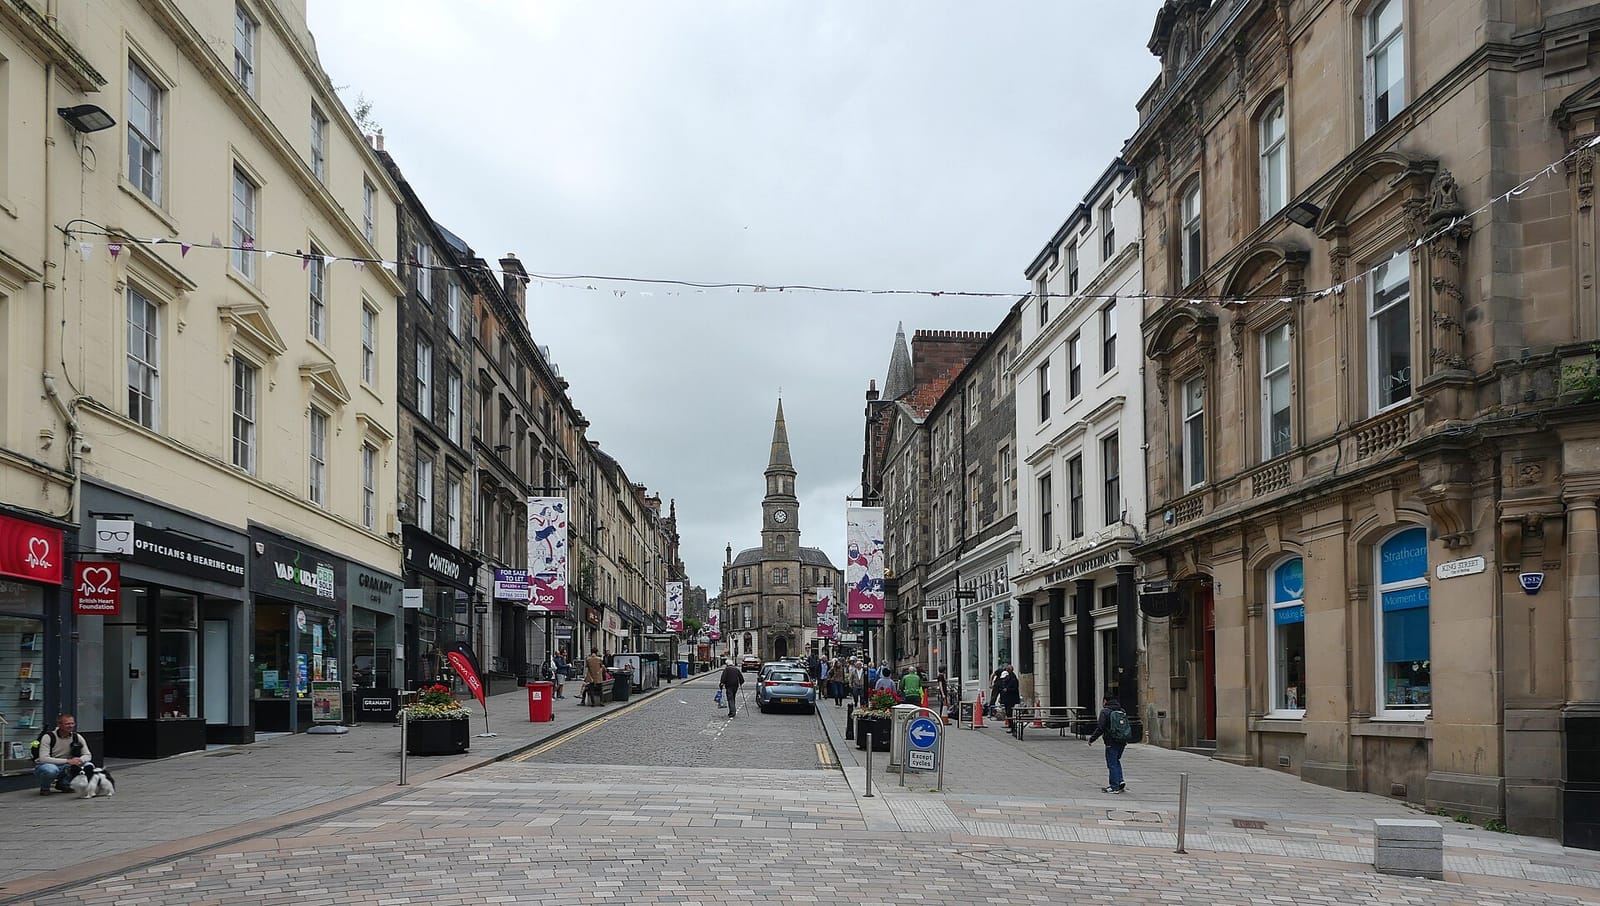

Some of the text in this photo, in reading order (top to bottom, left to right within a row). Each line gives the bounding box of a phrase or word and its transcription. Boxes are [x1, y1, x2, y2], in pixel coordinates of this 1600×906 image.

[135, 539, 244, 575] OPTICIANS & HEARING CARE
[1075, 549, 1120, 575] COFFEEHOUSE
[428, 552, 460, 579] CONTEMPO
[1441, 563, 1457, 572] KING
[1458, 559, 1478, 569] STREET
[318, 570, 333, 583] CBD
[359, 573, 393, 595] GRANARY
[1384, 593, 1416, 606] Moment
[1279, 609, 1299, 620] Making
[912, 752, 932, 760] Except
